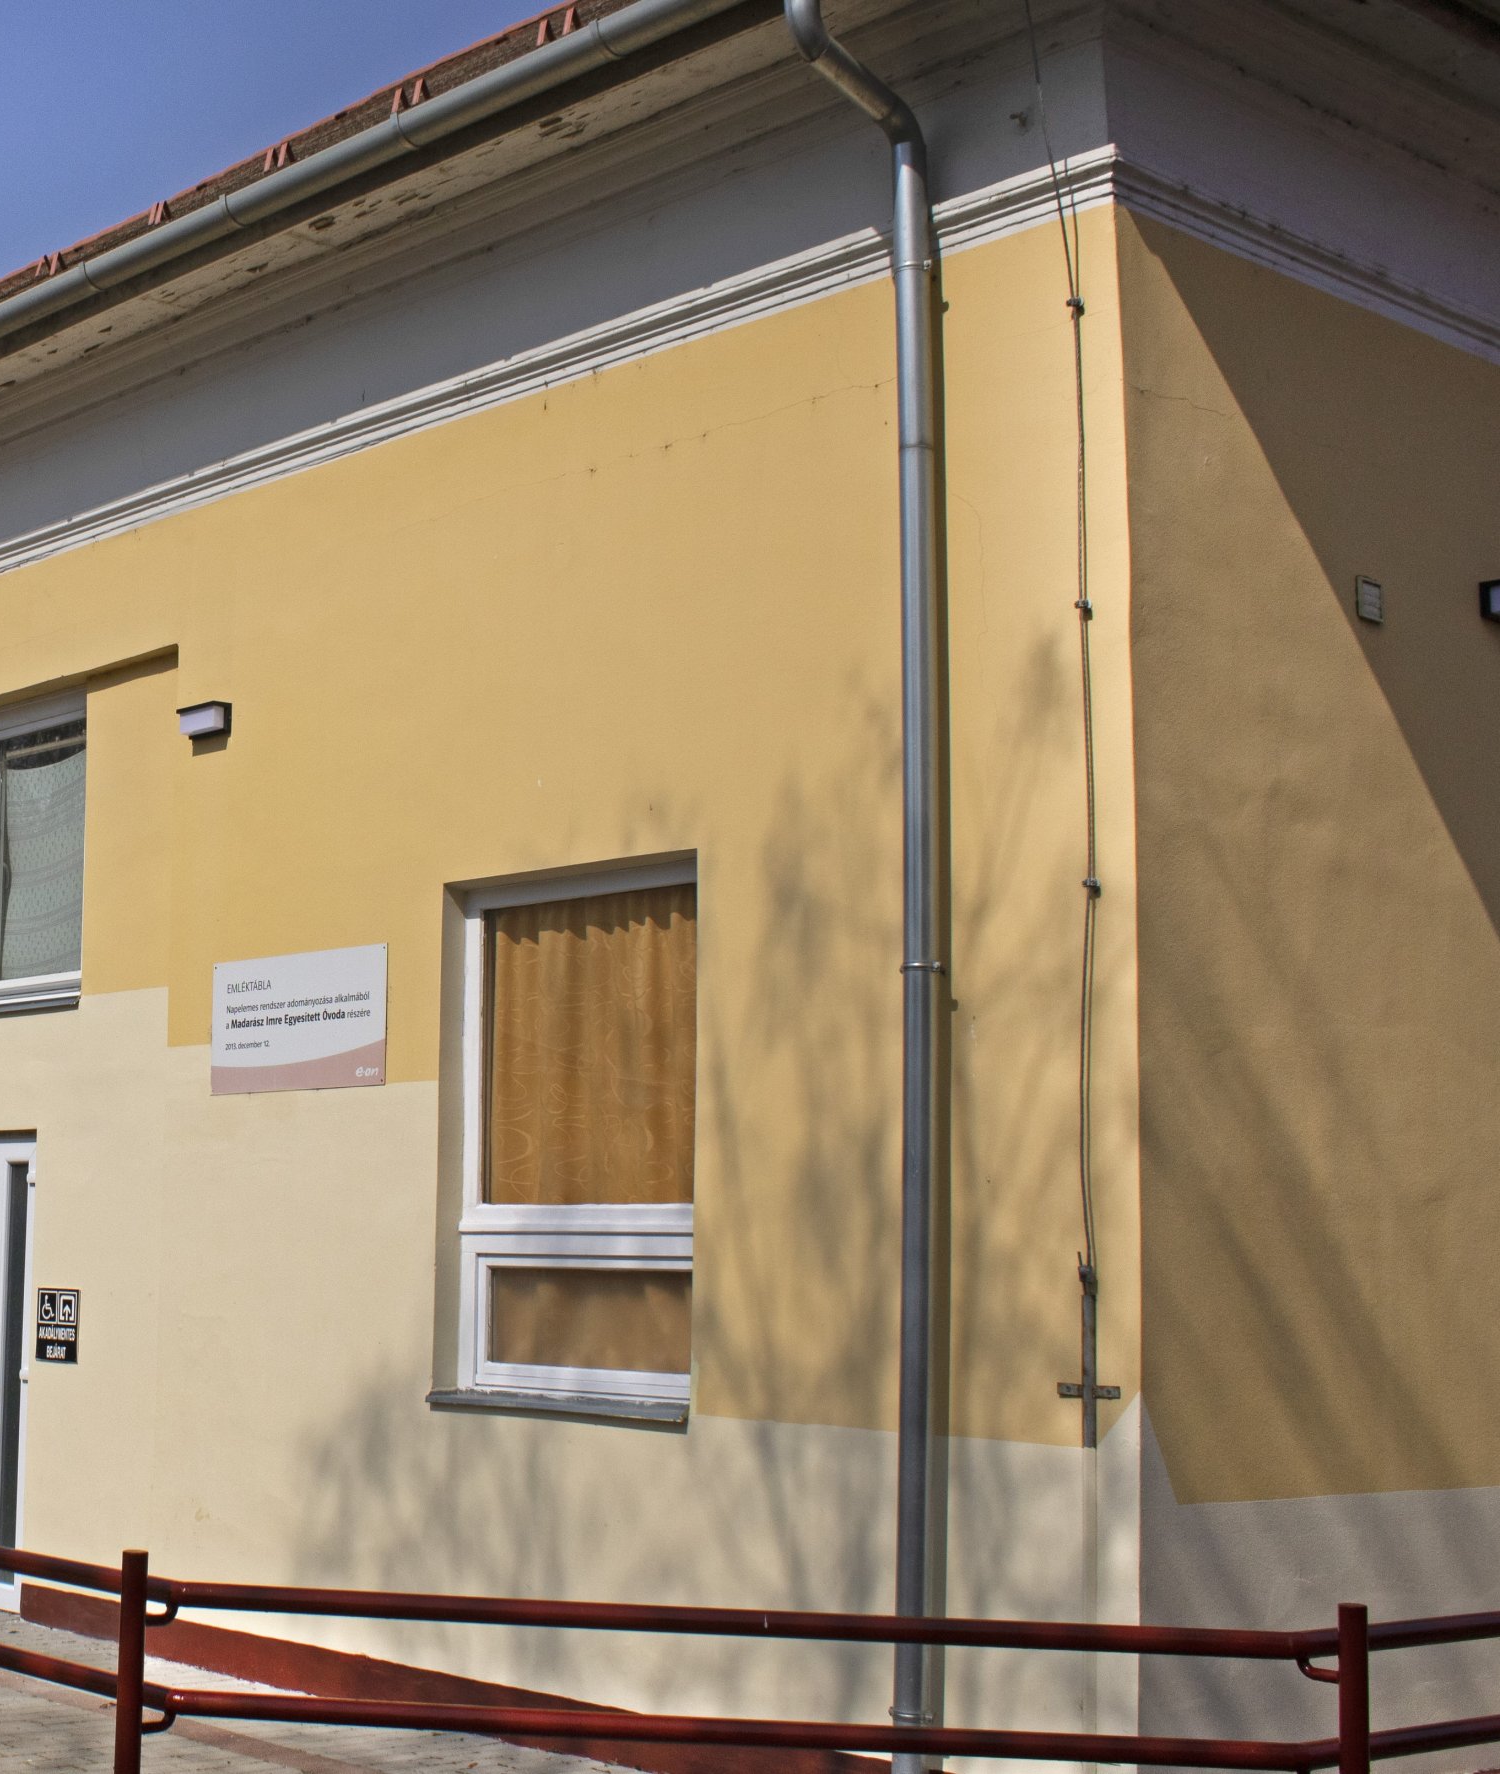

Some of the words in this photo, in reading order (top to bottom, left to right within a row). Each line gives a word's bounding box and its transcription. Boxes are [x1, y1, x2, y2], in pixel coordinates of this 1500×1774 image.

[227, 979, 271, 994] EMLÉKTÁBLA
[226, 1003, 259, 1015] Napelemes
[260, 1001, 286, 1011] rendszer
[287, 995, 333, 1008] adományozása
[334, 991, 370, 1003] alkalmából
[225, 1022, 230, 1030] a
[231, 1016, 264, 1029] Madarász
[266, 1016, 282, 1026] Imre
[284, 1012, 321, 1026] Egyesített
[322, 1008, 346, 1021] Óvoda
[346, 1009, 371, 1018] részére
[238, 1040, 262, 1049] december
[38, 1324, 76, 1341] AKADÁLYMENTES
[46, 1342, 67, 1359] BEJÁRAT
